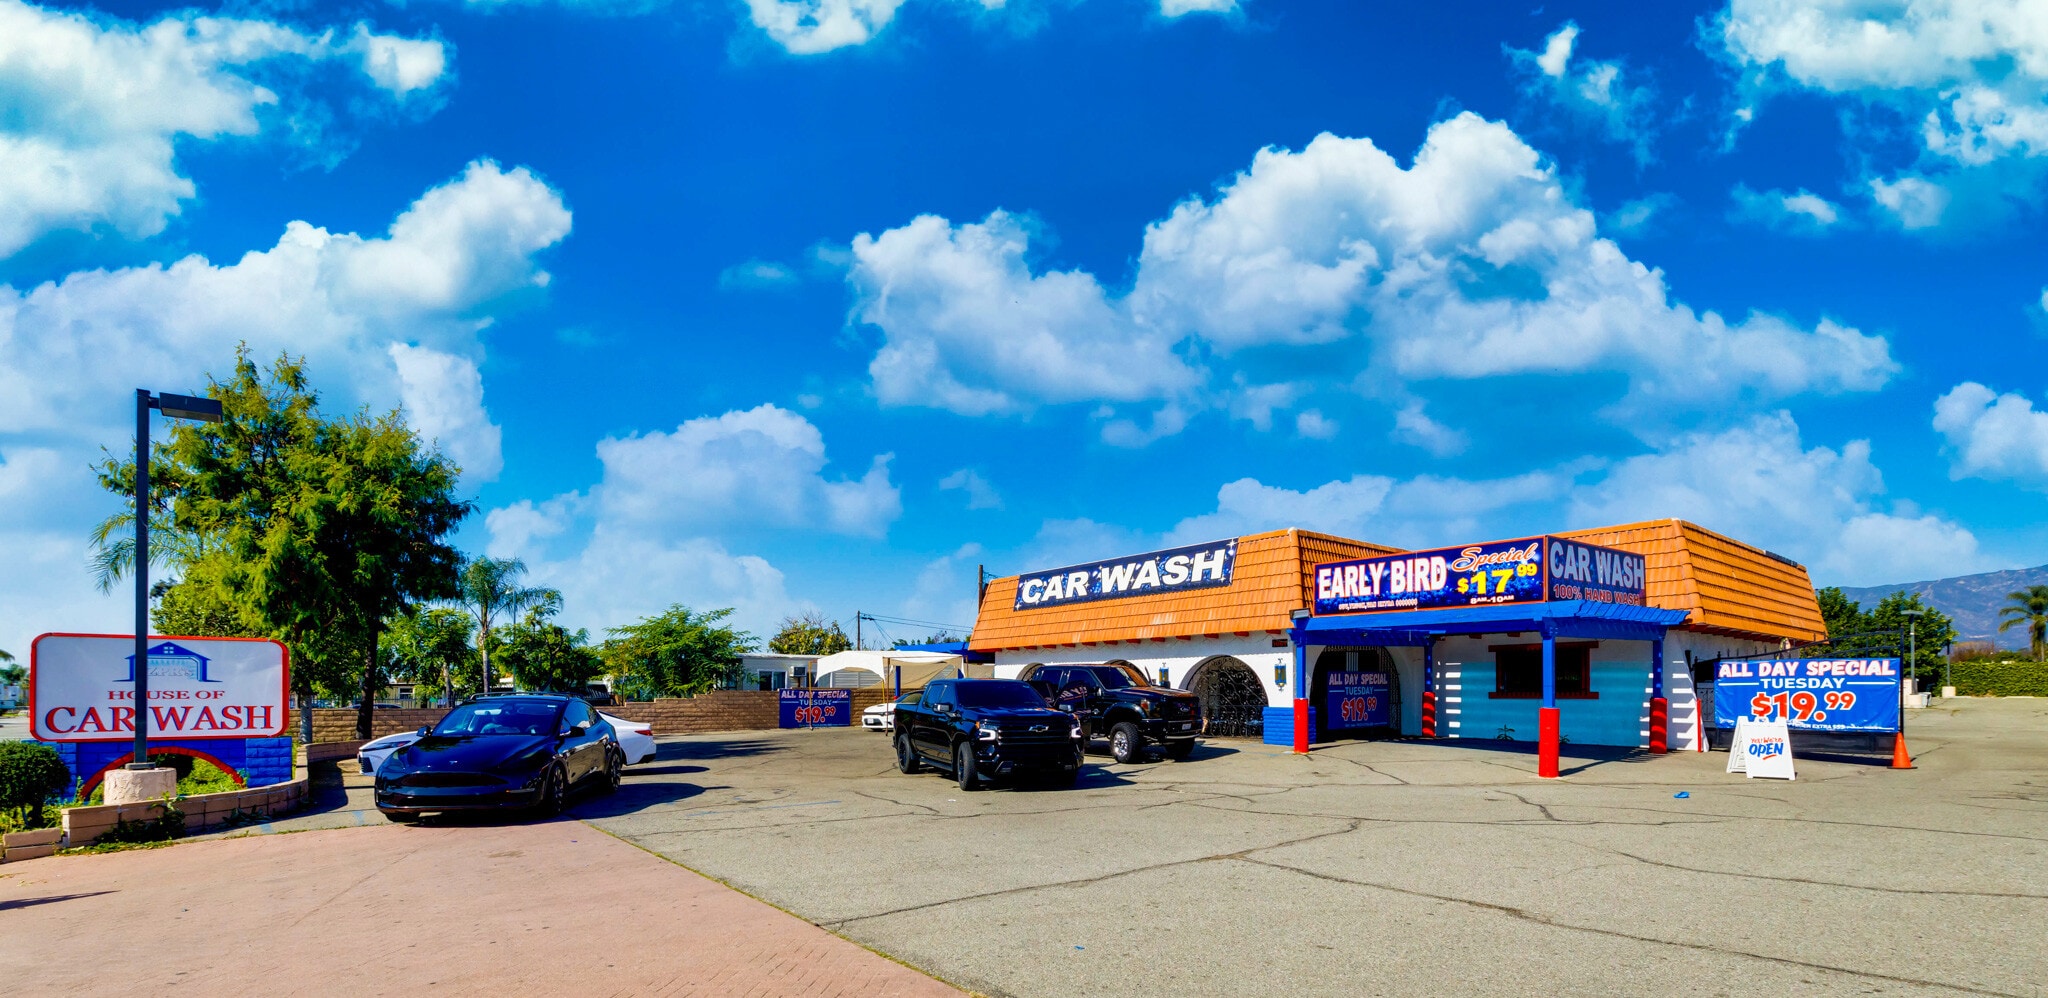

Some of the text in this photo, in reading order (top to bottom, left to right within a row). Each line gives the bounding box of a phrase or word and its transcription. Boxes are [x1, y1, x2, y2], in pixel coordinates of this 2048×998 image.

[1452, 542, 1538, 572] Special
[1550, 541, 1645, 590] CAR WASH
[1021, 548, 1226, 604] CAR WASH
[1318, 556, 1447, 600] EARLY BIRD
[1553, 584, 1641, 606] 100% HAND WASH
[1329, 673, 1388, 685] ALL DAY SPECIAL
[1718, 660, 1896, 679] ALL DAY SPECIAL
[1345, 686, 1374, 695] TUESDAY
[1759, 677, 1845, 690] TUESDAY
[108, 690, 226, 700] HOUSE OF
[818, 690, 849, 698] SPECIAL
[45, 705, 274, 734] CAR WASH
